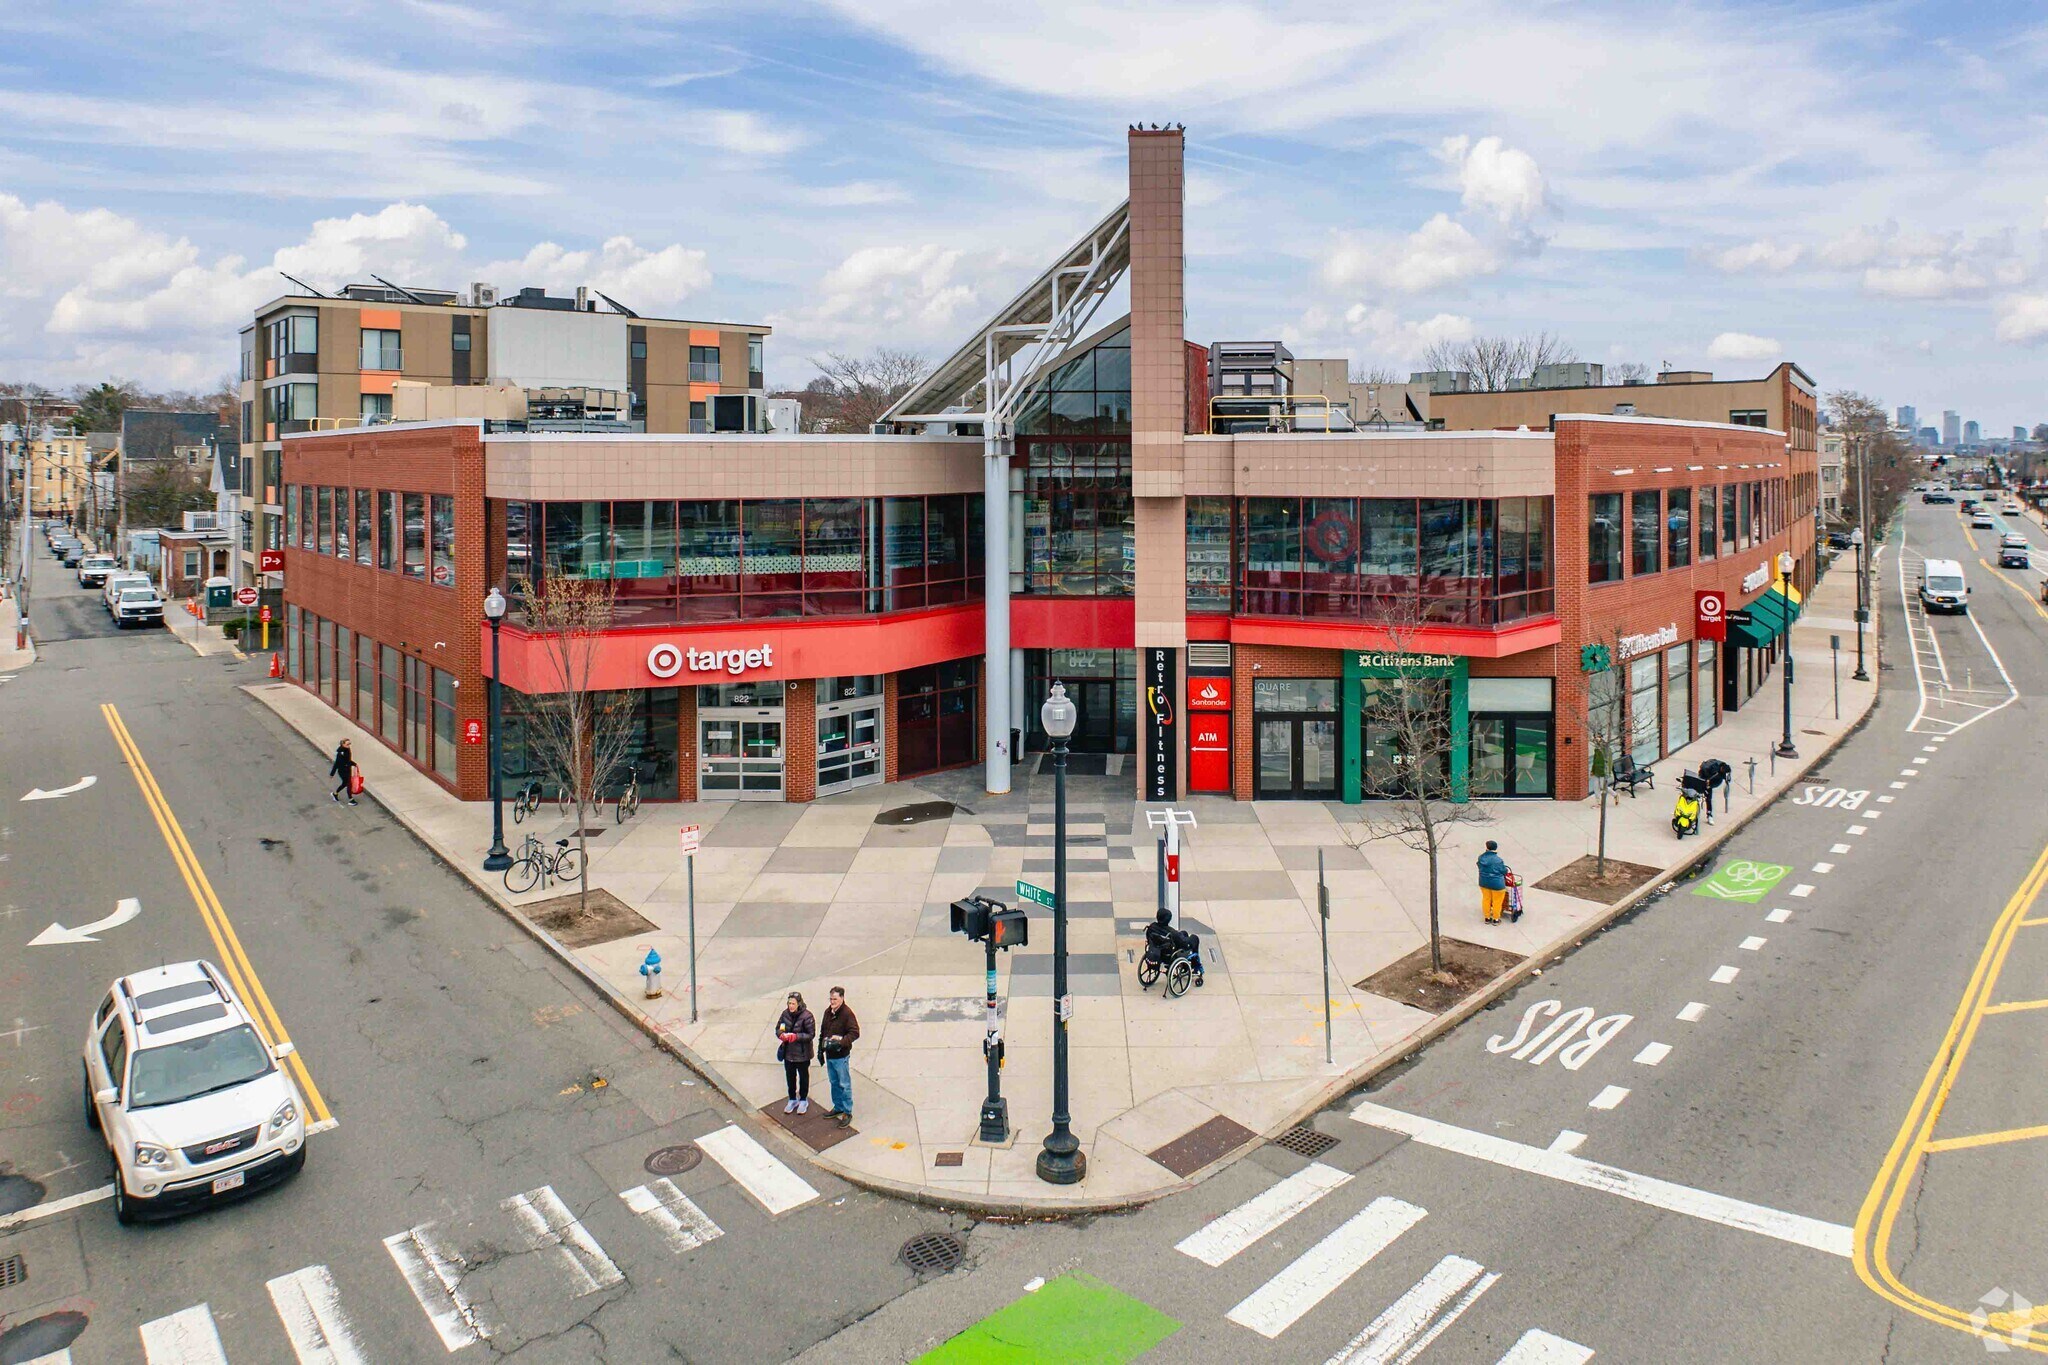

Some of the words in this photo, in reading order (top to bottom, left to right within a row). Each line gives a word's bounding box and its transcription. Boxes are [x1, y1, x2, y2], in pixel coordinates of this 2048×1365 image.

[262, 556, 273, 568] P
[1700, 614, 1722, 623] target
[686, 643, 773, 676] target
[1372, 654, 1421, 667] Citizens
[1423, 654, 1455, 667] Bank
[1156, 650, 1165, 705] Retro
[844, 686, 857, 697] 822
[733, 694, 750, 703] 822
[1191, 698, 1227, 706] Santander
[1198, 732, 1218, 742] ATM
[1792, 785, 1871, 810] BUS
[1019, 882, 1042, 902] WHITE
[1046, 896, 1053, 906] ST
[1485, 999, 1635, 1071] BUS
[205, 1136, 241, 1155] GMC
